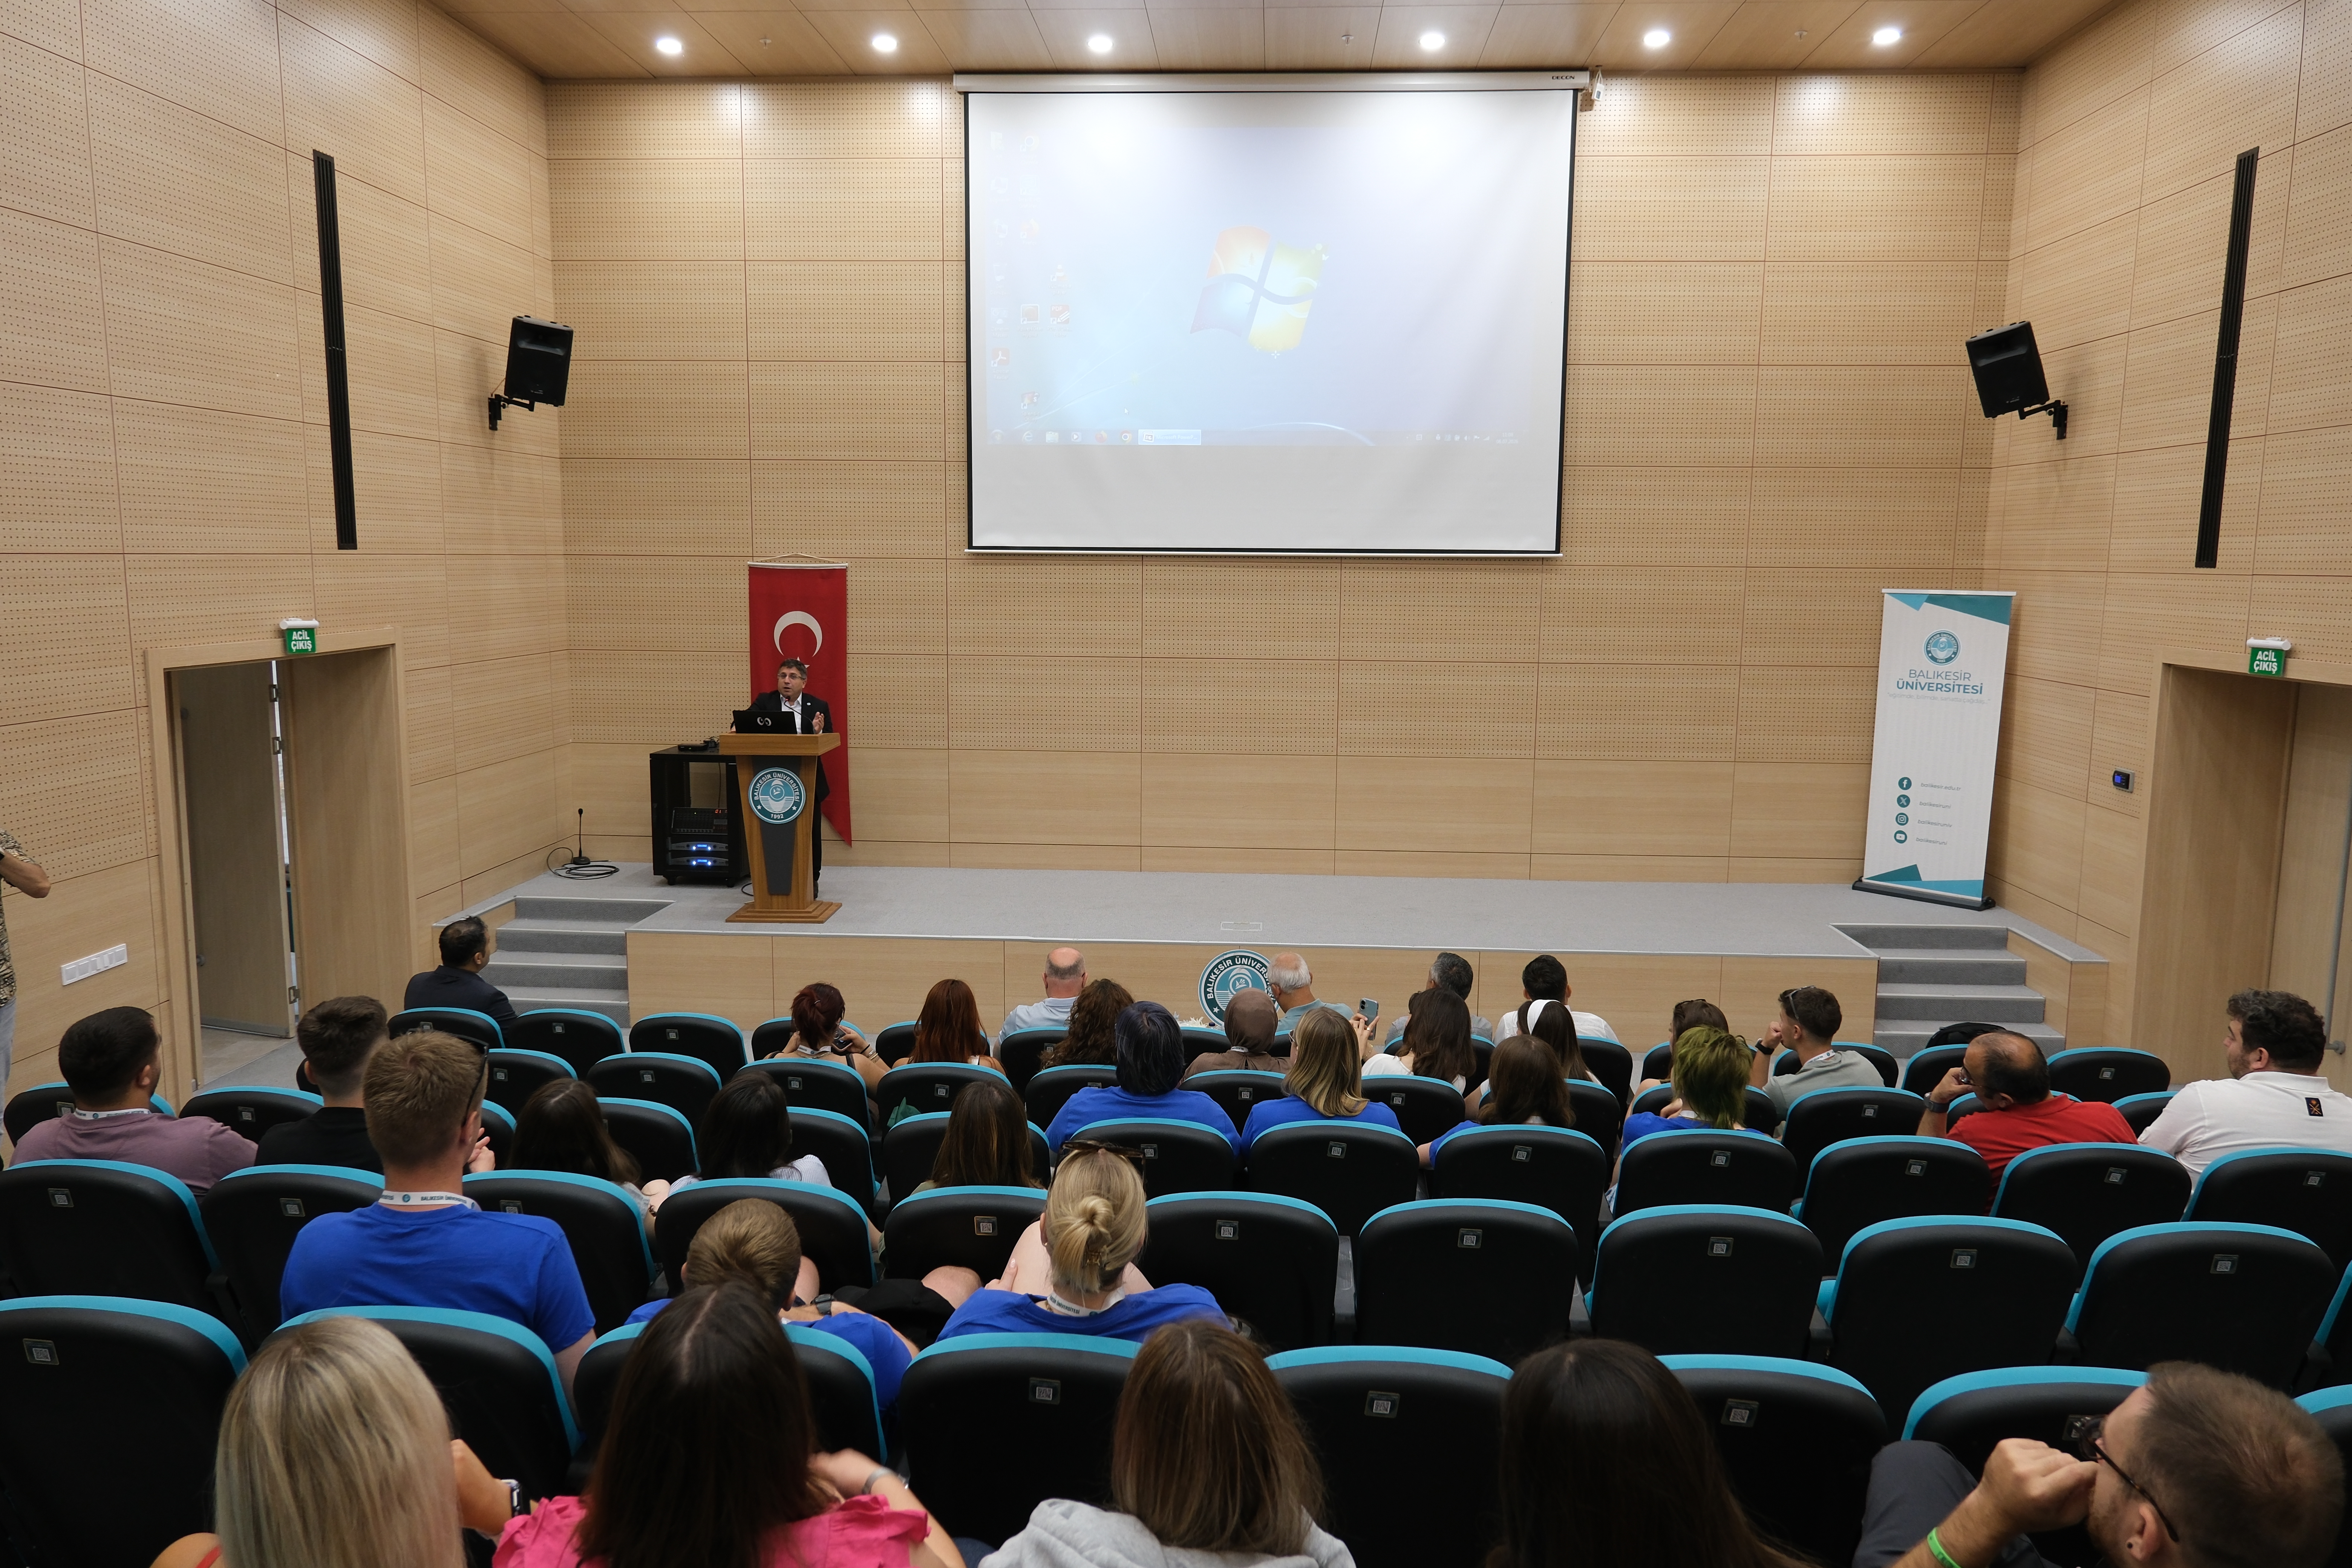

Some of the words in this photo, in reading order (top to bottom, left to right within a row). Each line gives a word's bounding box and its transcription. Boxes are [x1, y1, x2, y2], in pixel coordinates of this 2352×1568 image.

[292, 630, 310, 640] ACİL
[291, 640, 312, 652] ÇIKIŞ
[2256, 650, 2277, 661] ACİL
[2254, 661, 2277, 674] ÇIKIŞ
[1909, 669, 1971, 681] BALIKESİR
[1897, 678, 1983, 694] ÜNİVERSİTESİ
[754, 774, 772, 800] BALIKESİR
[773, 772, 800, 802] ÜNİVERSİTESİ
[1207, 959, 1233, 999] BALIKESİR
